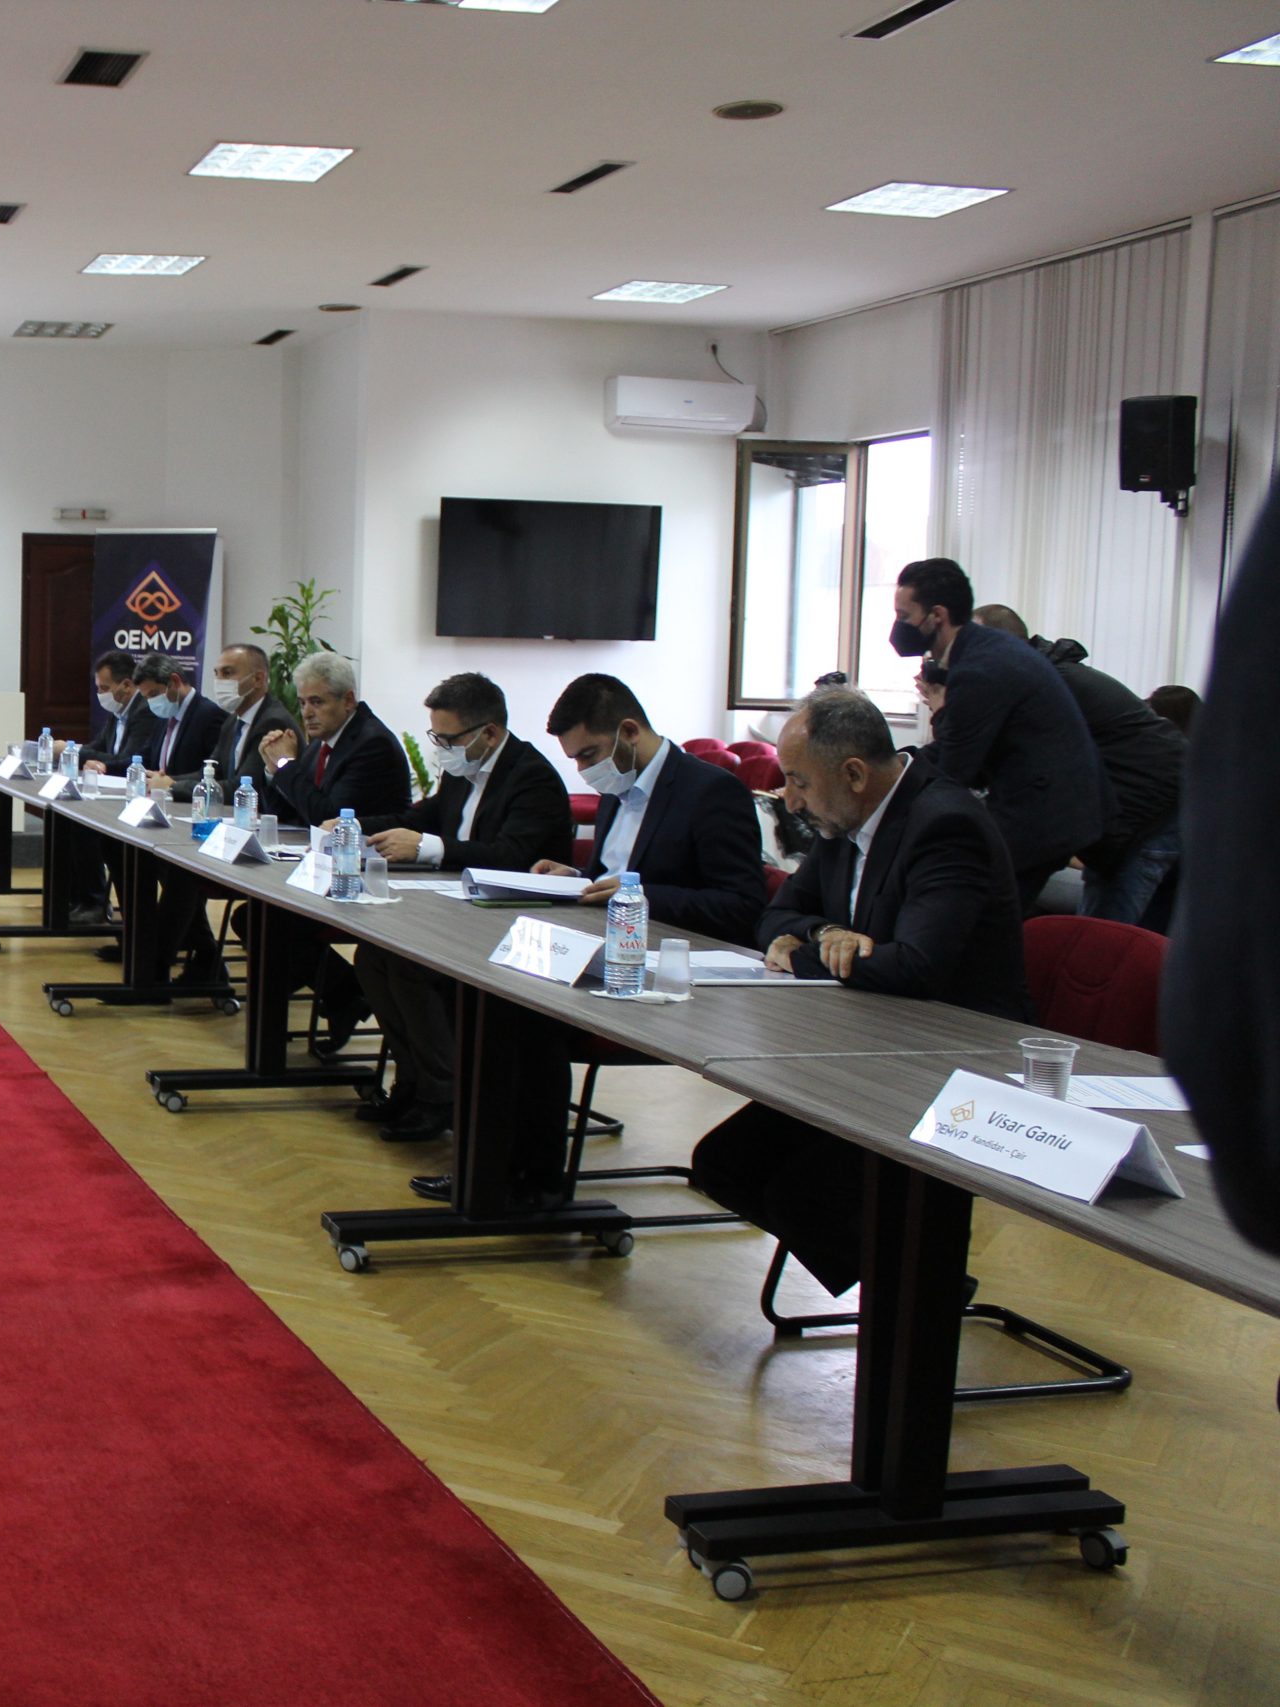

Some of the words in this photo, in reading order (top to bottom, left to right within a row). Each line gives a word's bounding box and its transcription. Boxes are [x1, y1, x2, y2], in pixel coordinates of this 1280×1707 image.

[114, 629, 192, 652] OEMVP
[987, 1110, 1026, 1134] Visar
[1025, 1125, 1073, 1151] Ganiu
[970, 1134, 1006, 1154] Kandidat
